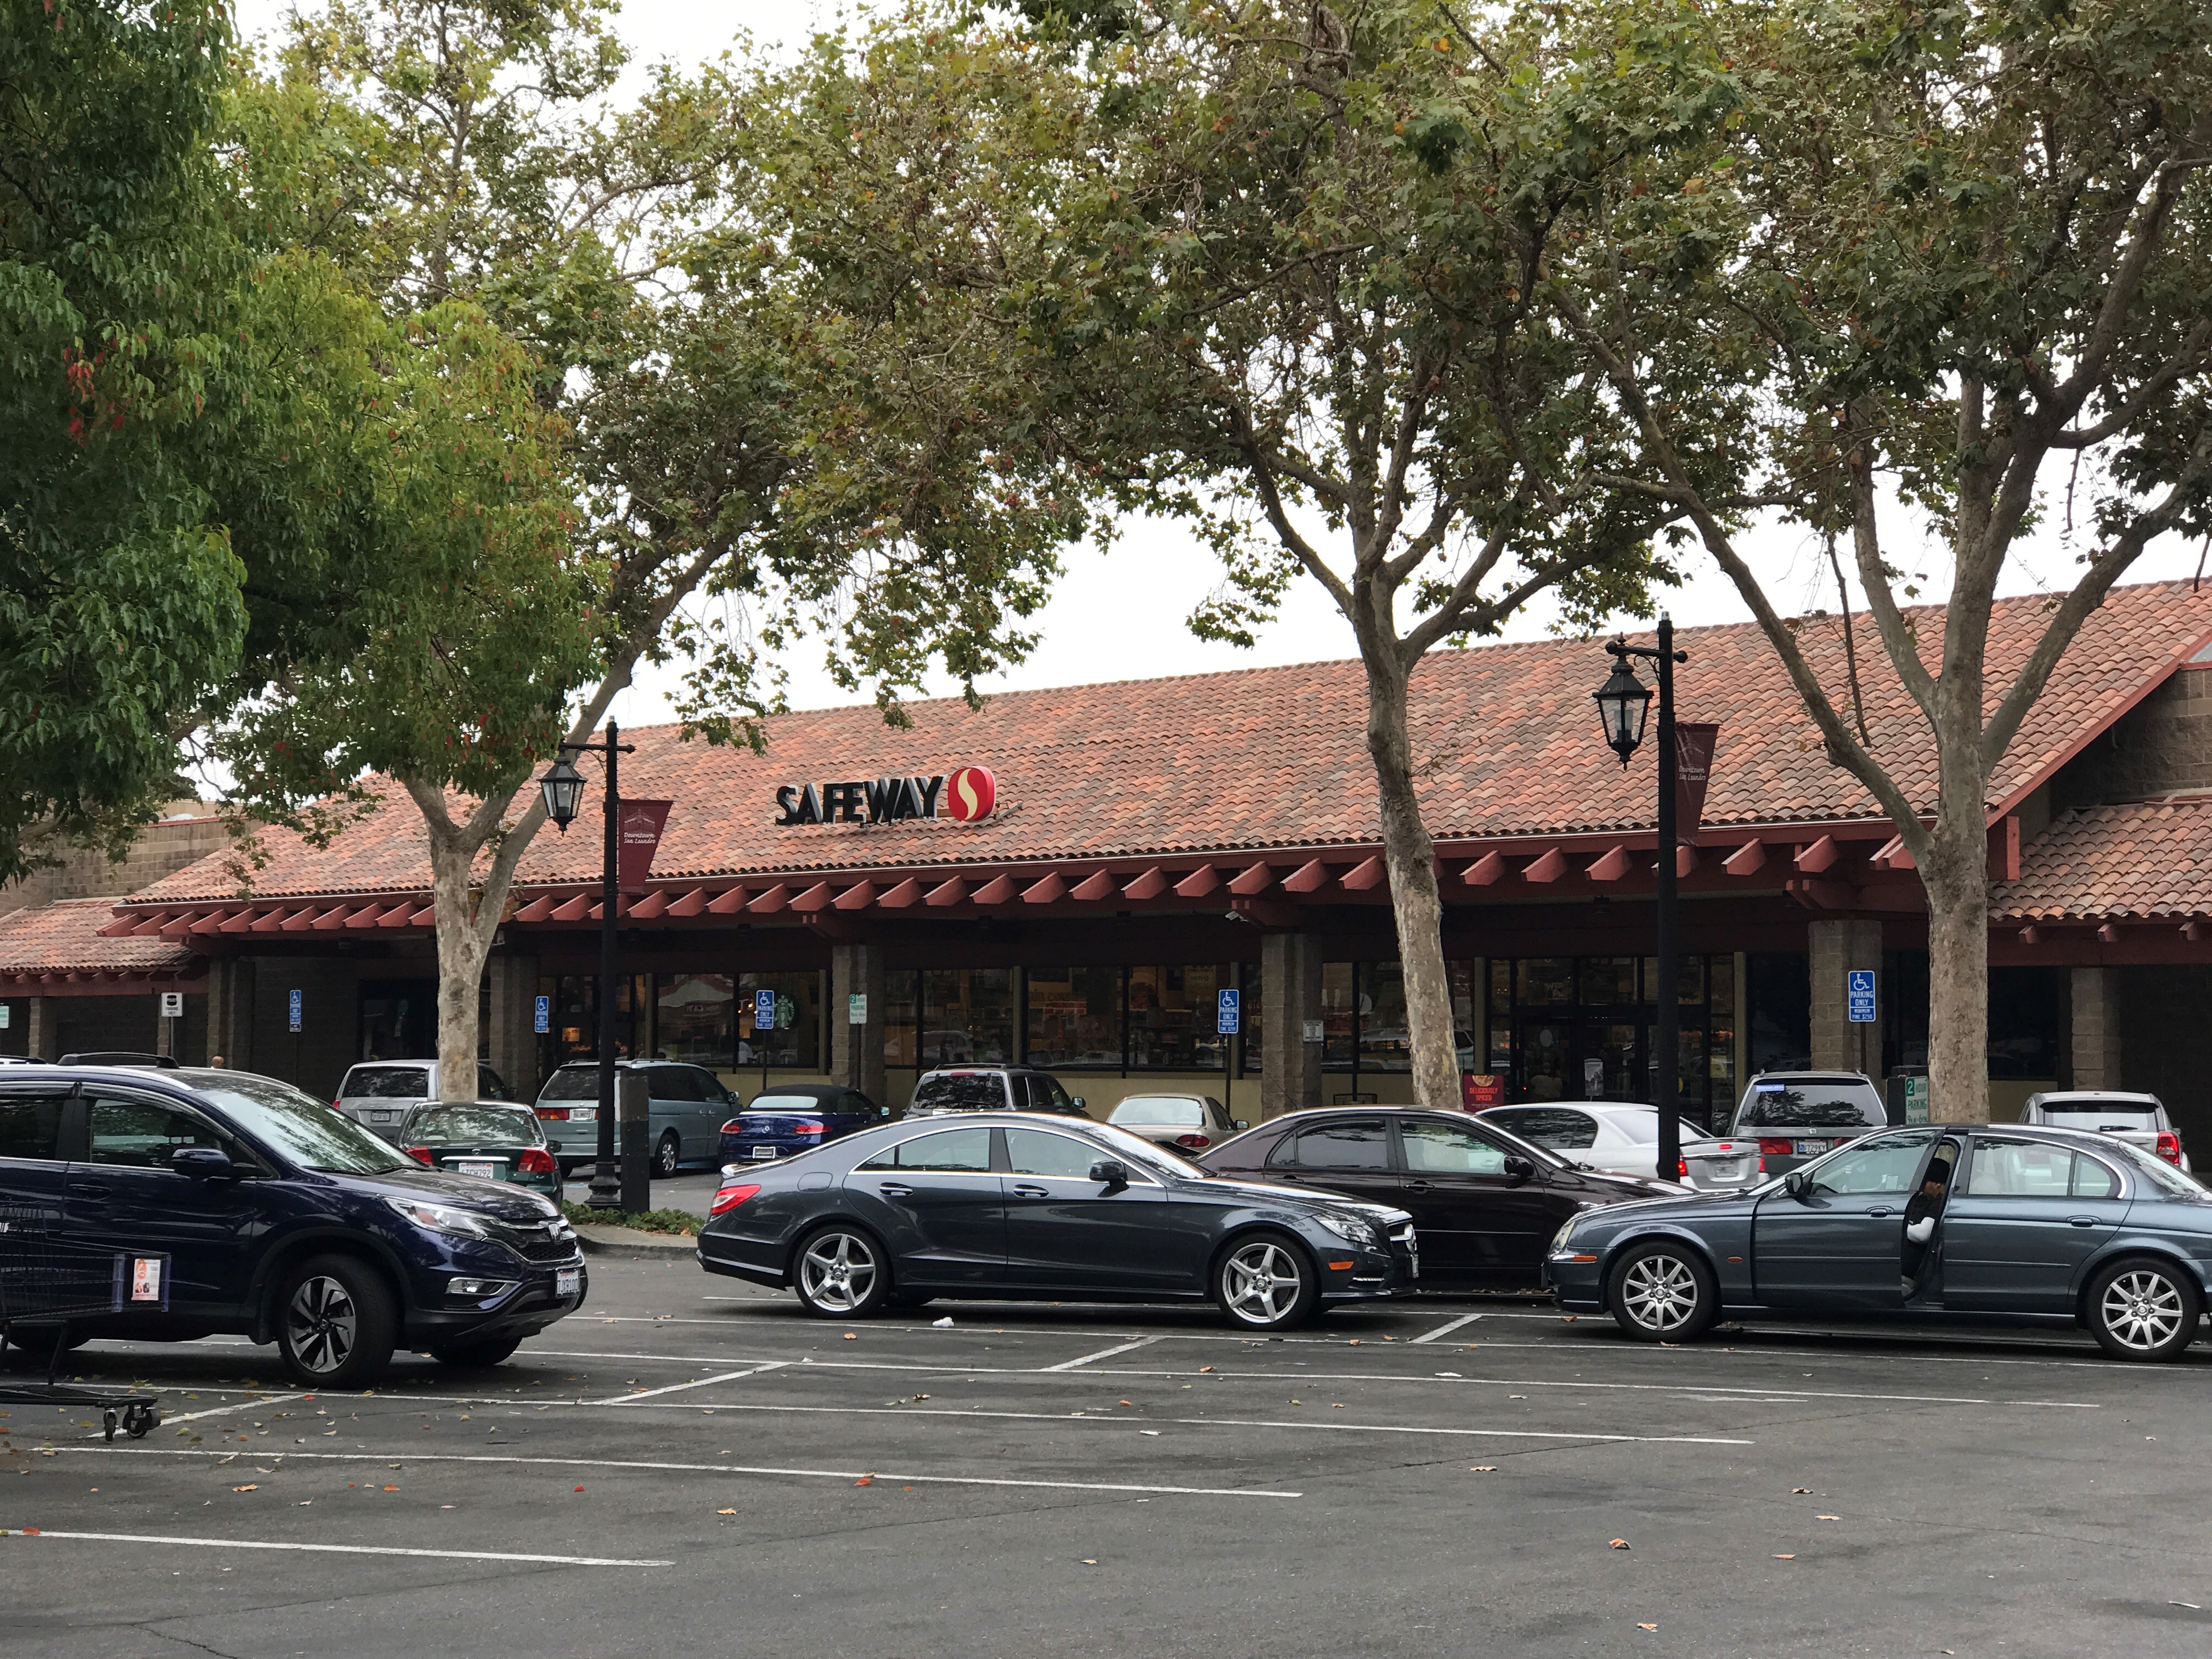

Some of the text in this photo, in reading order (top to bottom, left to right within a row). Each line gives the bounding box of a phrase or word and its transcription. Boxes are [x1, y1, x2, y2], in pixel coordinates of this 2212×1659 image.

[775, 774, 947, 826] SAFEWAY
[1908, 1081, 1914, 1094] 2
[1908, 1098, 1927, 1110] PARKING
